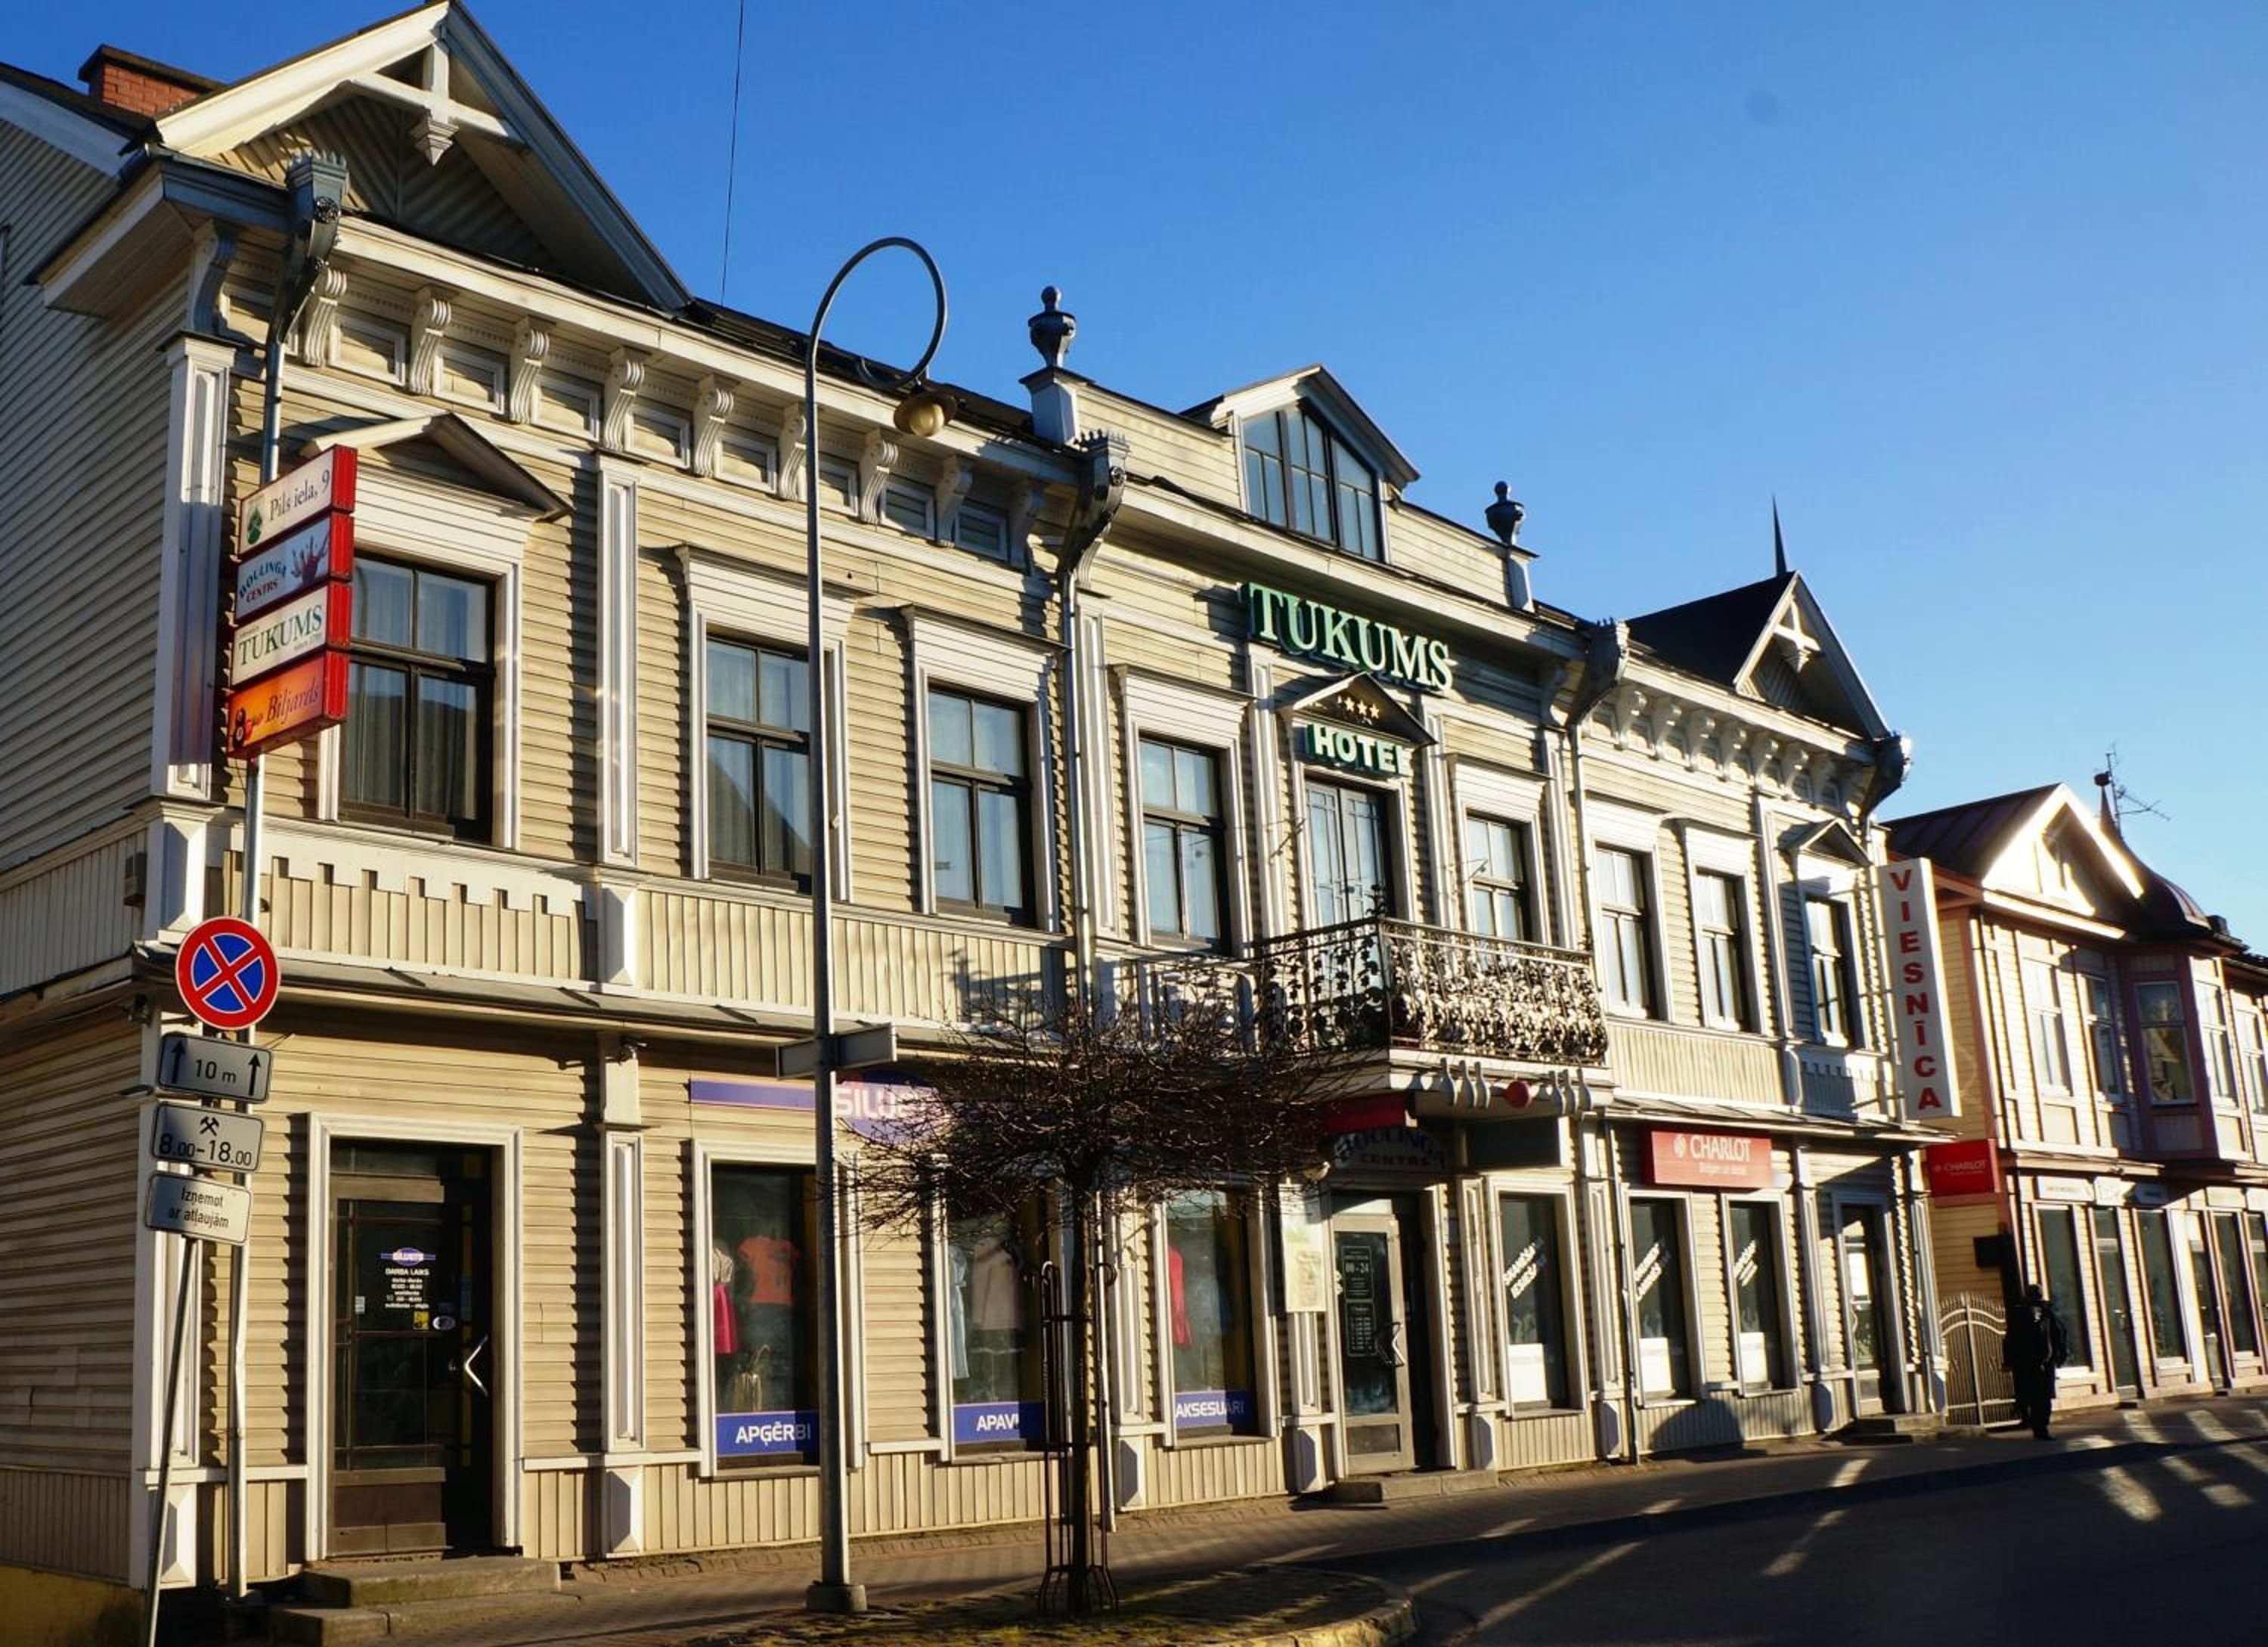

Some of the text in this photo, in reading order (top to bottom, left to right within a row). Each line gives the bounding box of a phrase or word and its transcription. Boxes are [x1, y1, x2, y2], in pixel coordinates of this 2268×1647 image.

[270, 470, 330, 521] Pils iela, 9
[246, 579, 278, 603] CENTRS
[239, 605, 323, 665] TUKUMS
[1249, 582, 1453, 691] TUKUMS
[265, 678, 318, 724] Biljards
[1312, 724, 1411, 776] HOTEL
[1890, 869, 1941, 1109] VIESNĪCA
[196, 1059, 236, 1084] 10 m
[160, 1134, 252, 1165] 8.00-18.00
[1690, 1135, 1752, 1162] CHARLOT
[181, 1186, 223, 1208] Izņemot
[735, 1421, 811, 1446] APĢĒRBI
